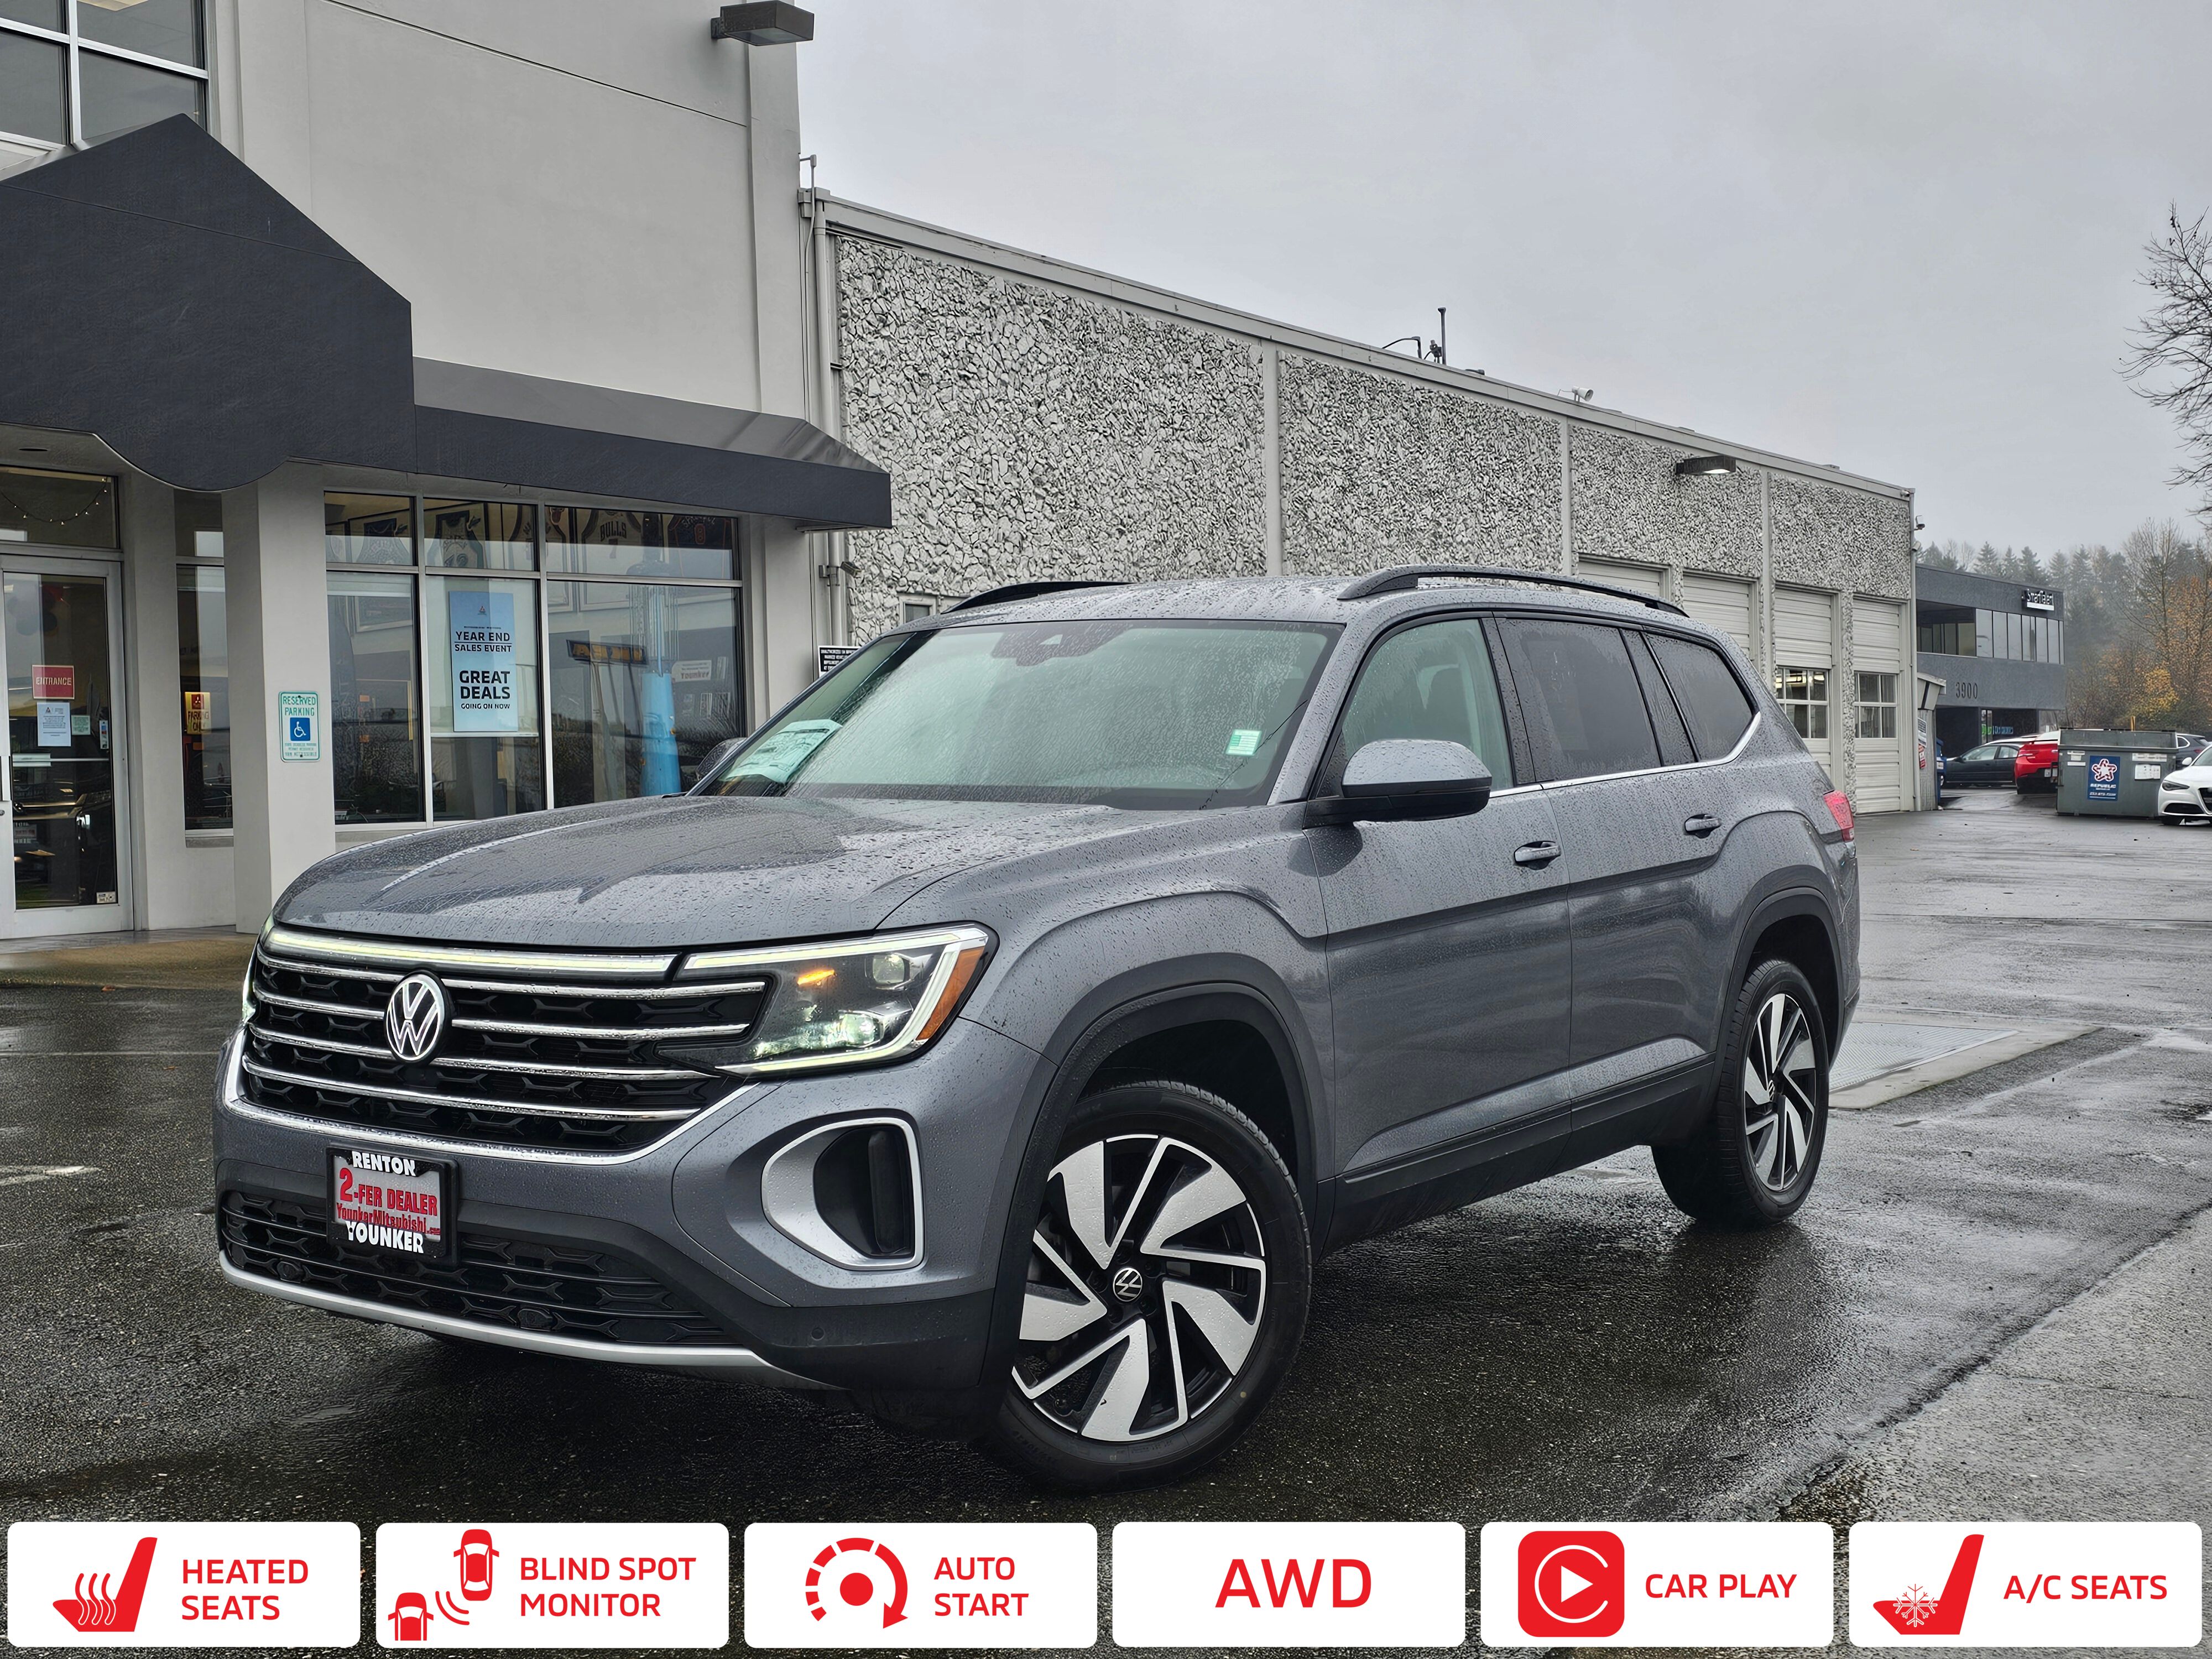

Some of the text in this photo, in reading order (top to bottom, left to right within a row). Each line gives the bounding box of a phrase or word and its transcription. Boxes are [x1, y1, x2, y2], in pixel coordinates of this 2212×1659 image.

[600, 521, 627, 542] BULLS
[456, 631, 510, 641] YEAR END
[455, 644, 482, 652] SALES
[36, 677, 72, 686] ENTRANCE
[460, 670, 510, 684] GREAT
[460, 686, 510, 700] DEALS
[1955, 682, 1978, 699] 3900
[283, 696, 316, 705] RESERVED
[187, 711, 210, 721] PARKG
[285, 707, 315, 716] PARKING
[352, 1151, 416, 1176] RENTON
[387, 1188, 438, 1216] DEALER
[345, 1220, 424, 1254] YOUNKER
